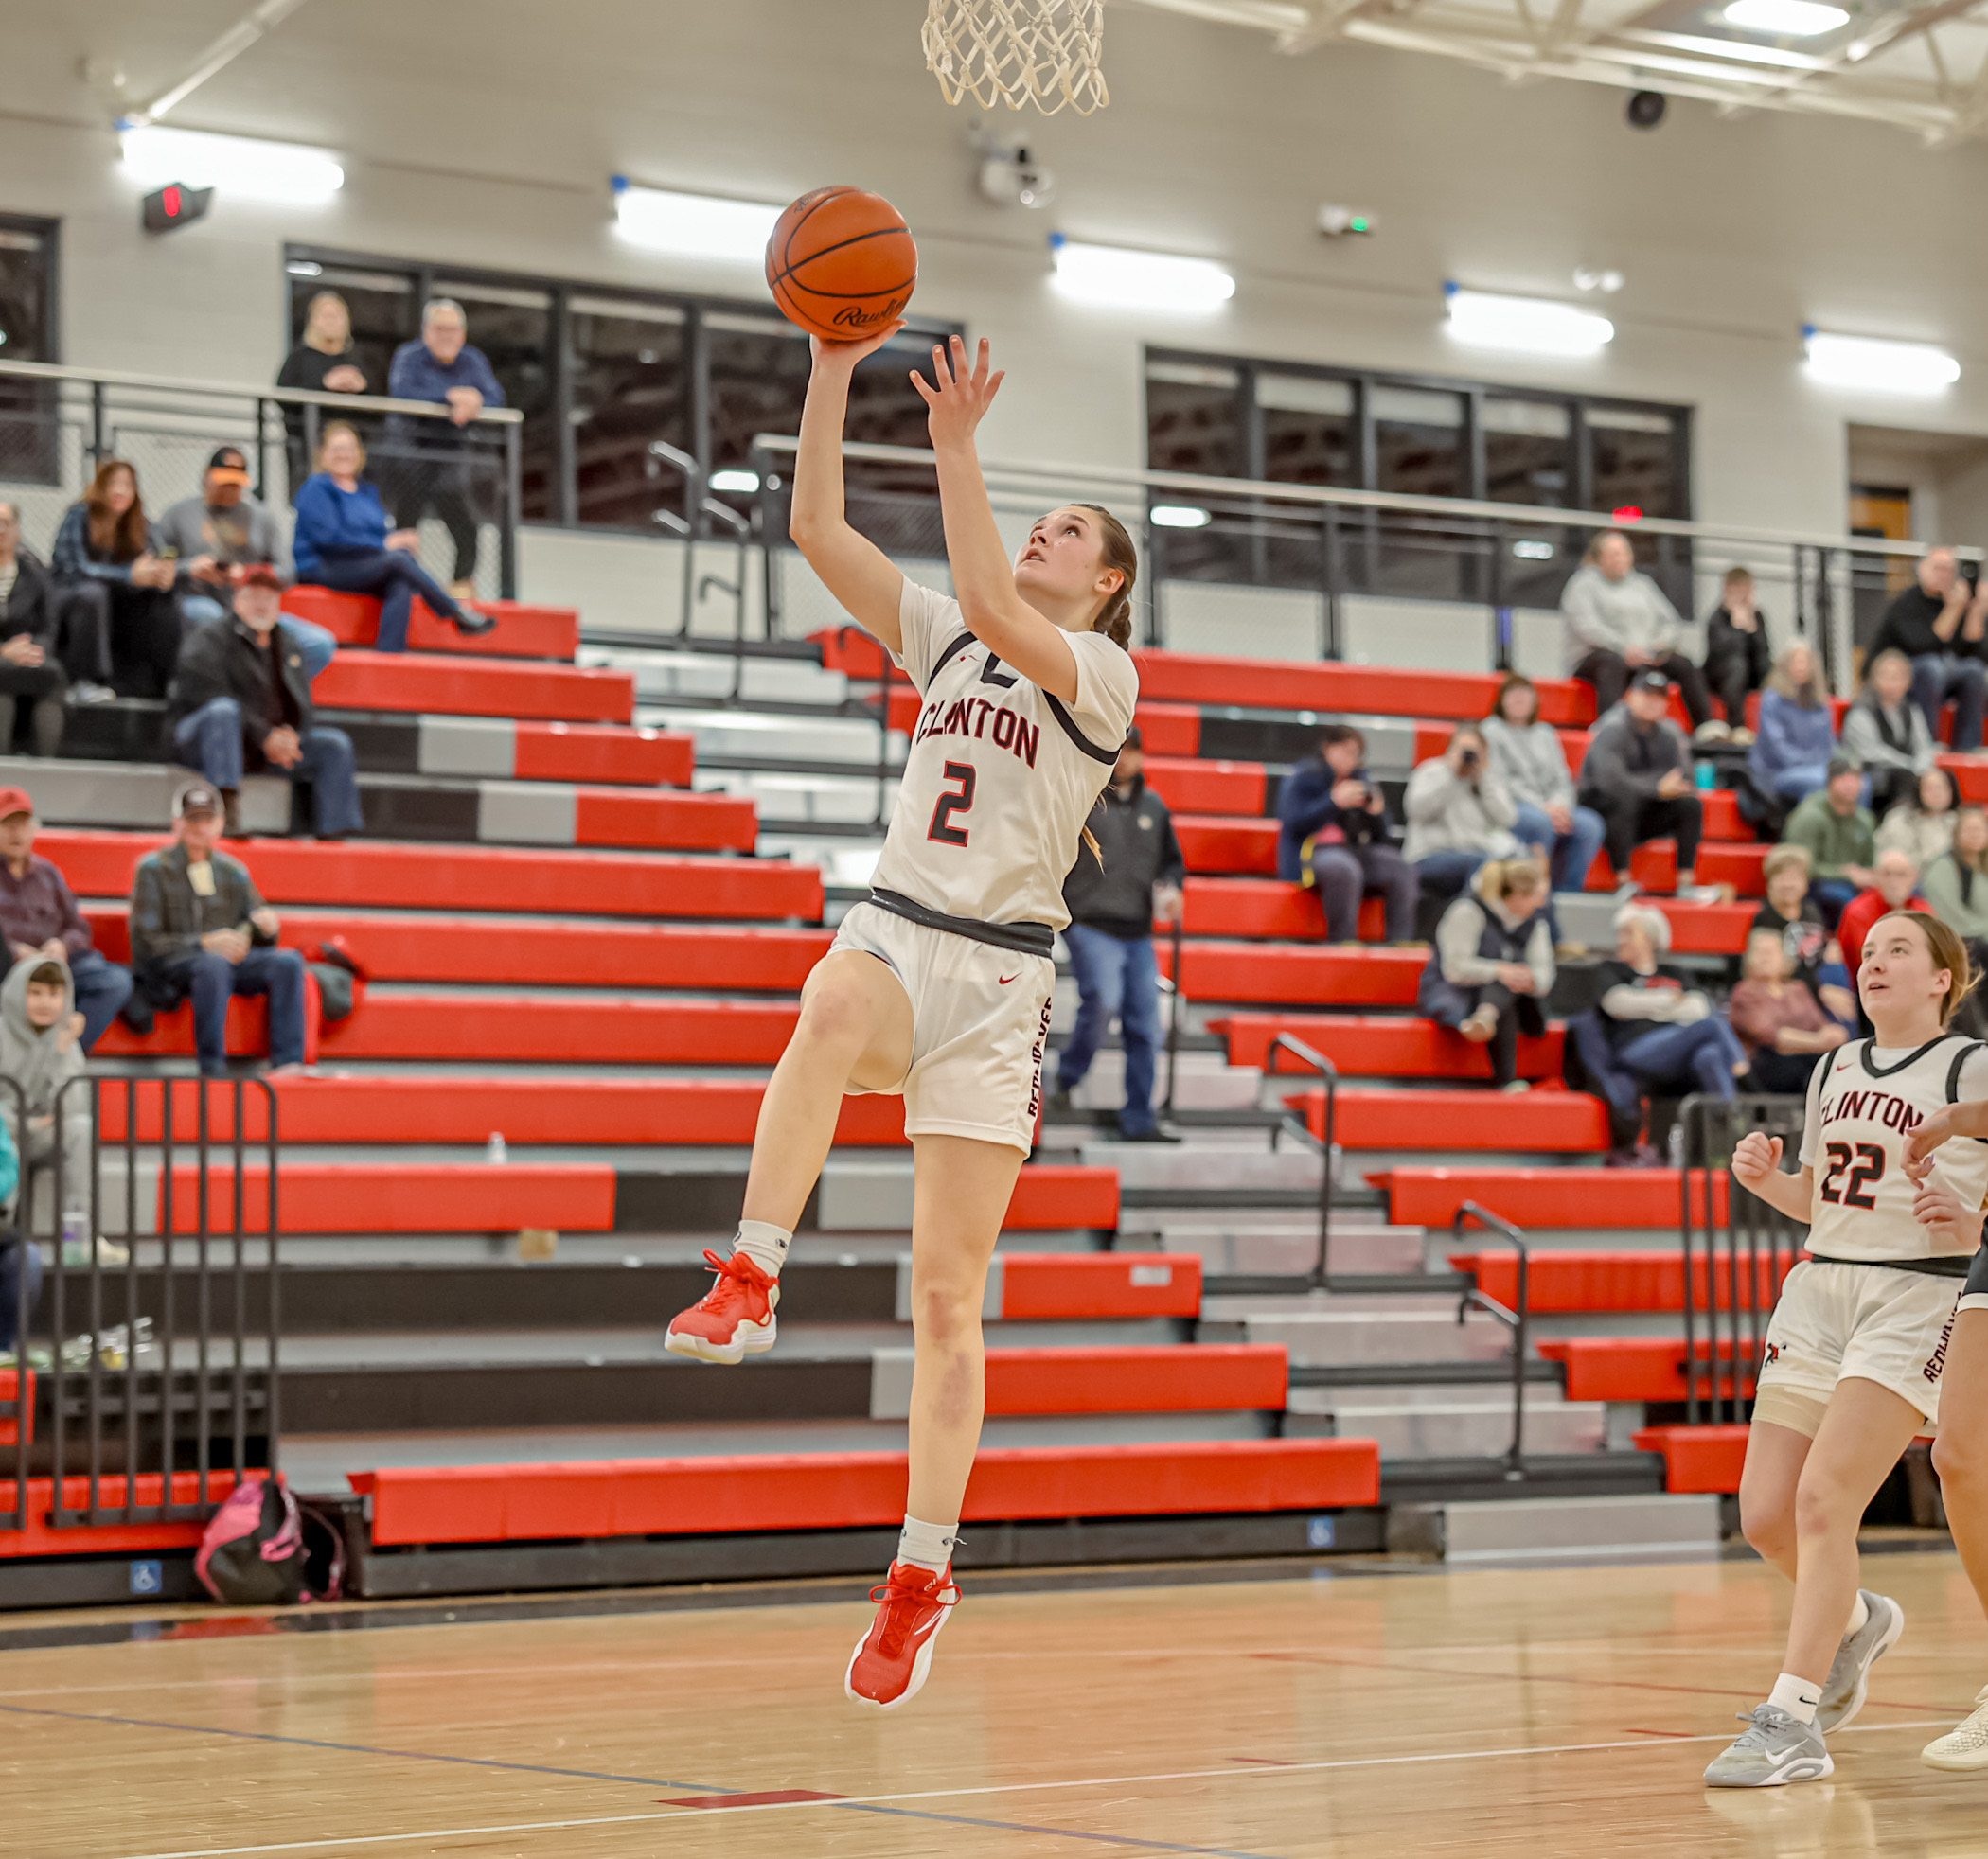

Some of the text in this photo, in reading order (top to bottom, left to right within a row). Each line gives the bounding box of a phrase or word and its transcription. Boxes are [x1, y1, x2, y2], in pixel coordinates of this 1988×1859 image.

[916, 697, 1039, 770] CLINTON
[927, 760, 976, 848] 2
[1821, 1142, 1886, 1211] 22
